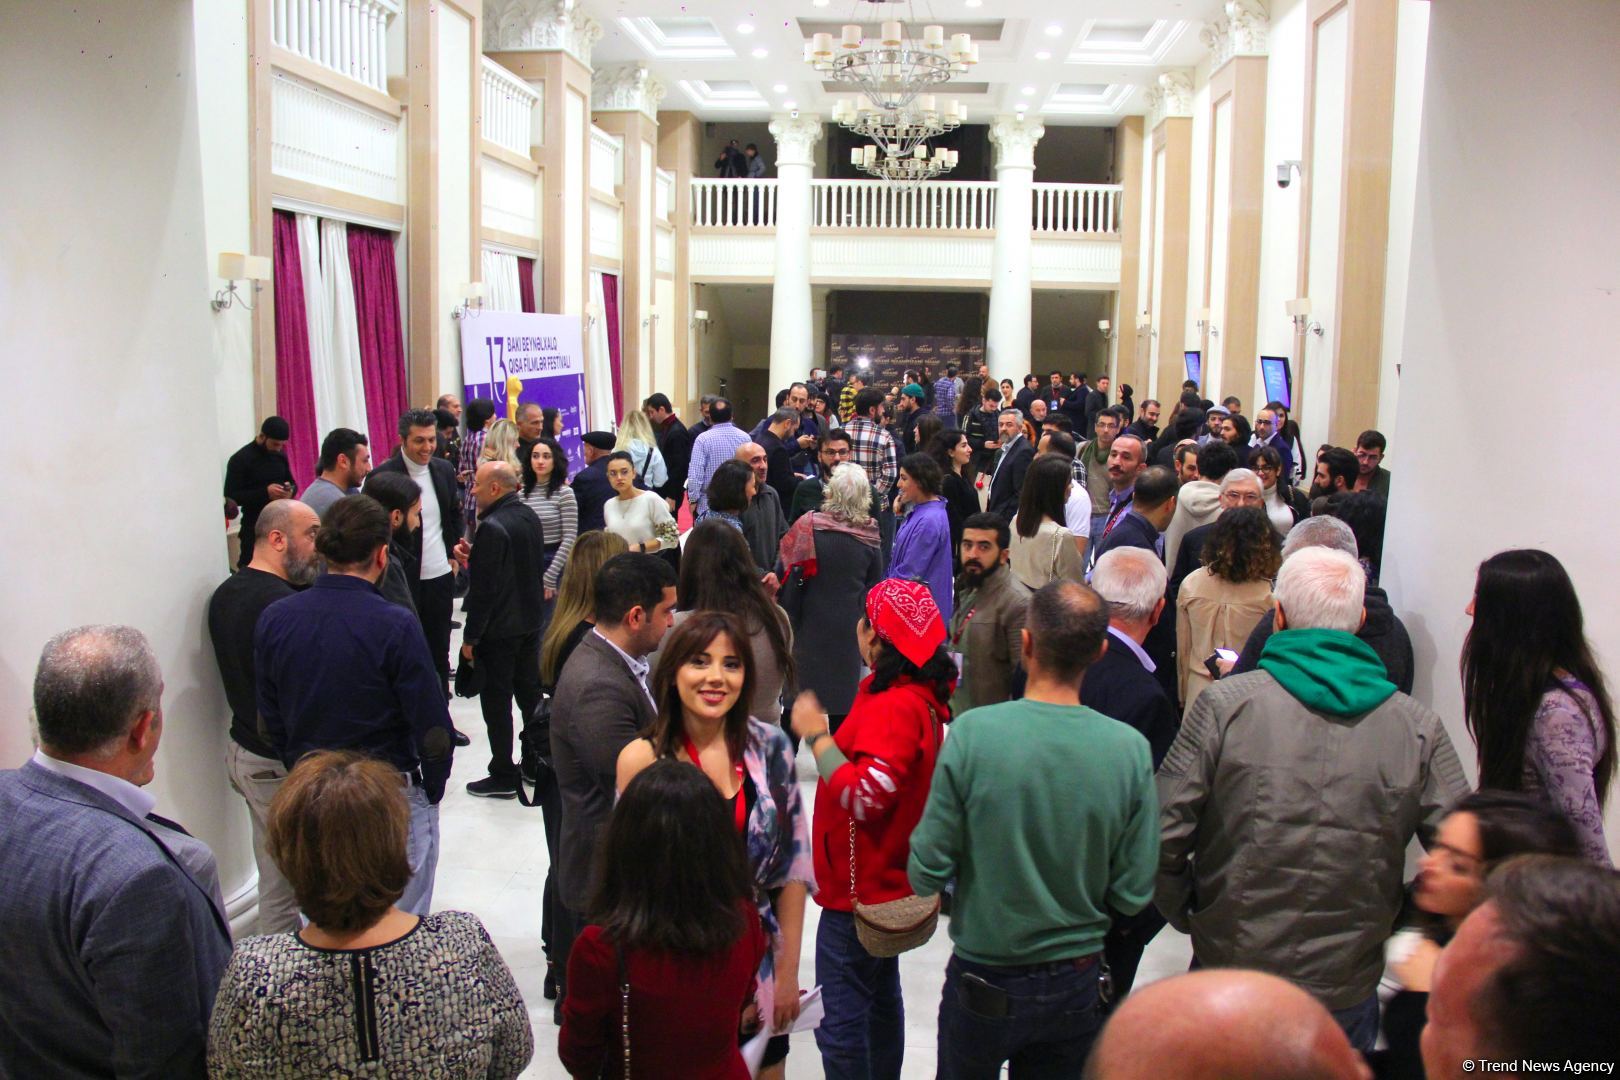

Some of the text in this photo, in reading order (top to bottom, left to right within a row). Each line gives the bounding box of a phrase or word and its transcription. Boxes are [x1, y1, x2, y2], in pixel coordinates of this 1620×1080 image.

[507, 337, 557, 352] BAKI BEYNƏLXALQ
[486, 337, 507, 403] 13
[508, 358, 523, 374] QISA
